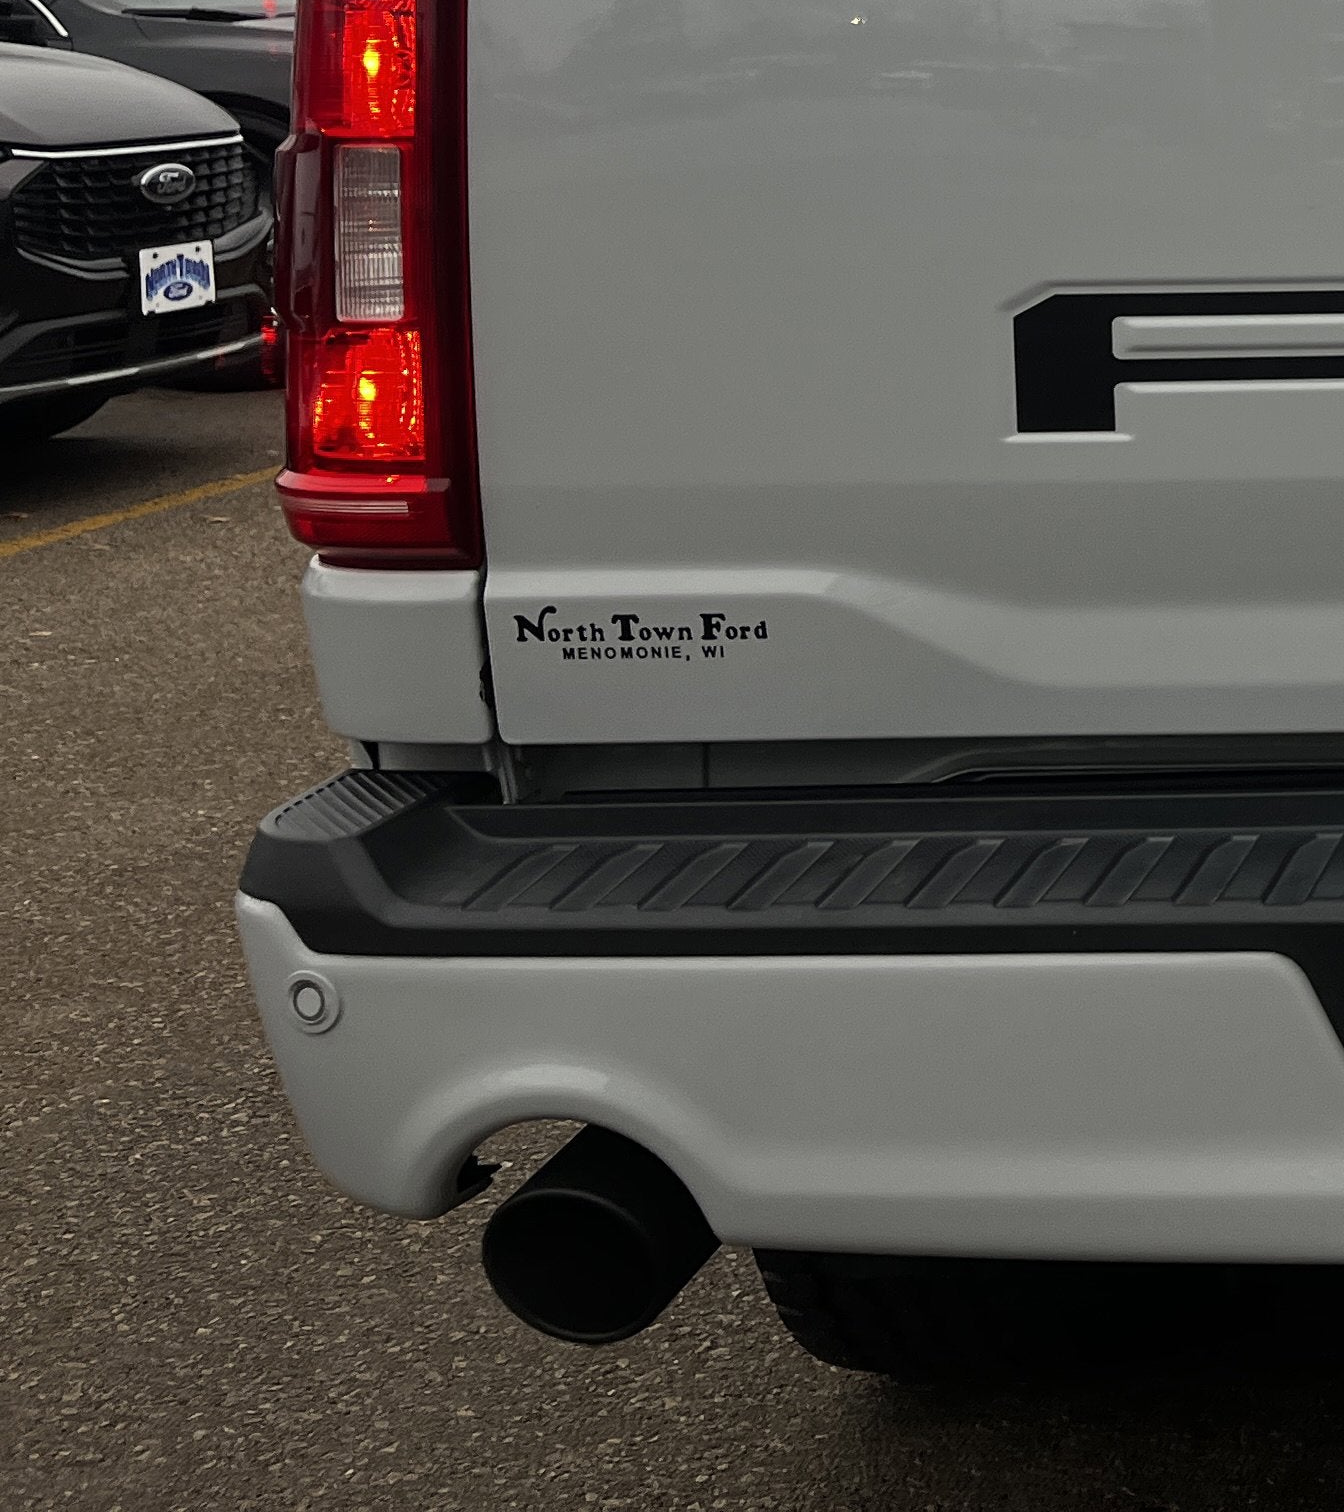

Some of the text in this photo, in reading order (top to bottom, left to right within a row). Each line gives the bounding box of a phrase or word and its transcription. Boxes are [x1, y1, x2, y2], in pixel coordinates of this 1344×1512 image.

[513, 605, 769, 643] North Town Ford
[561, 645, 726, 662] MENOMONIE, WI
